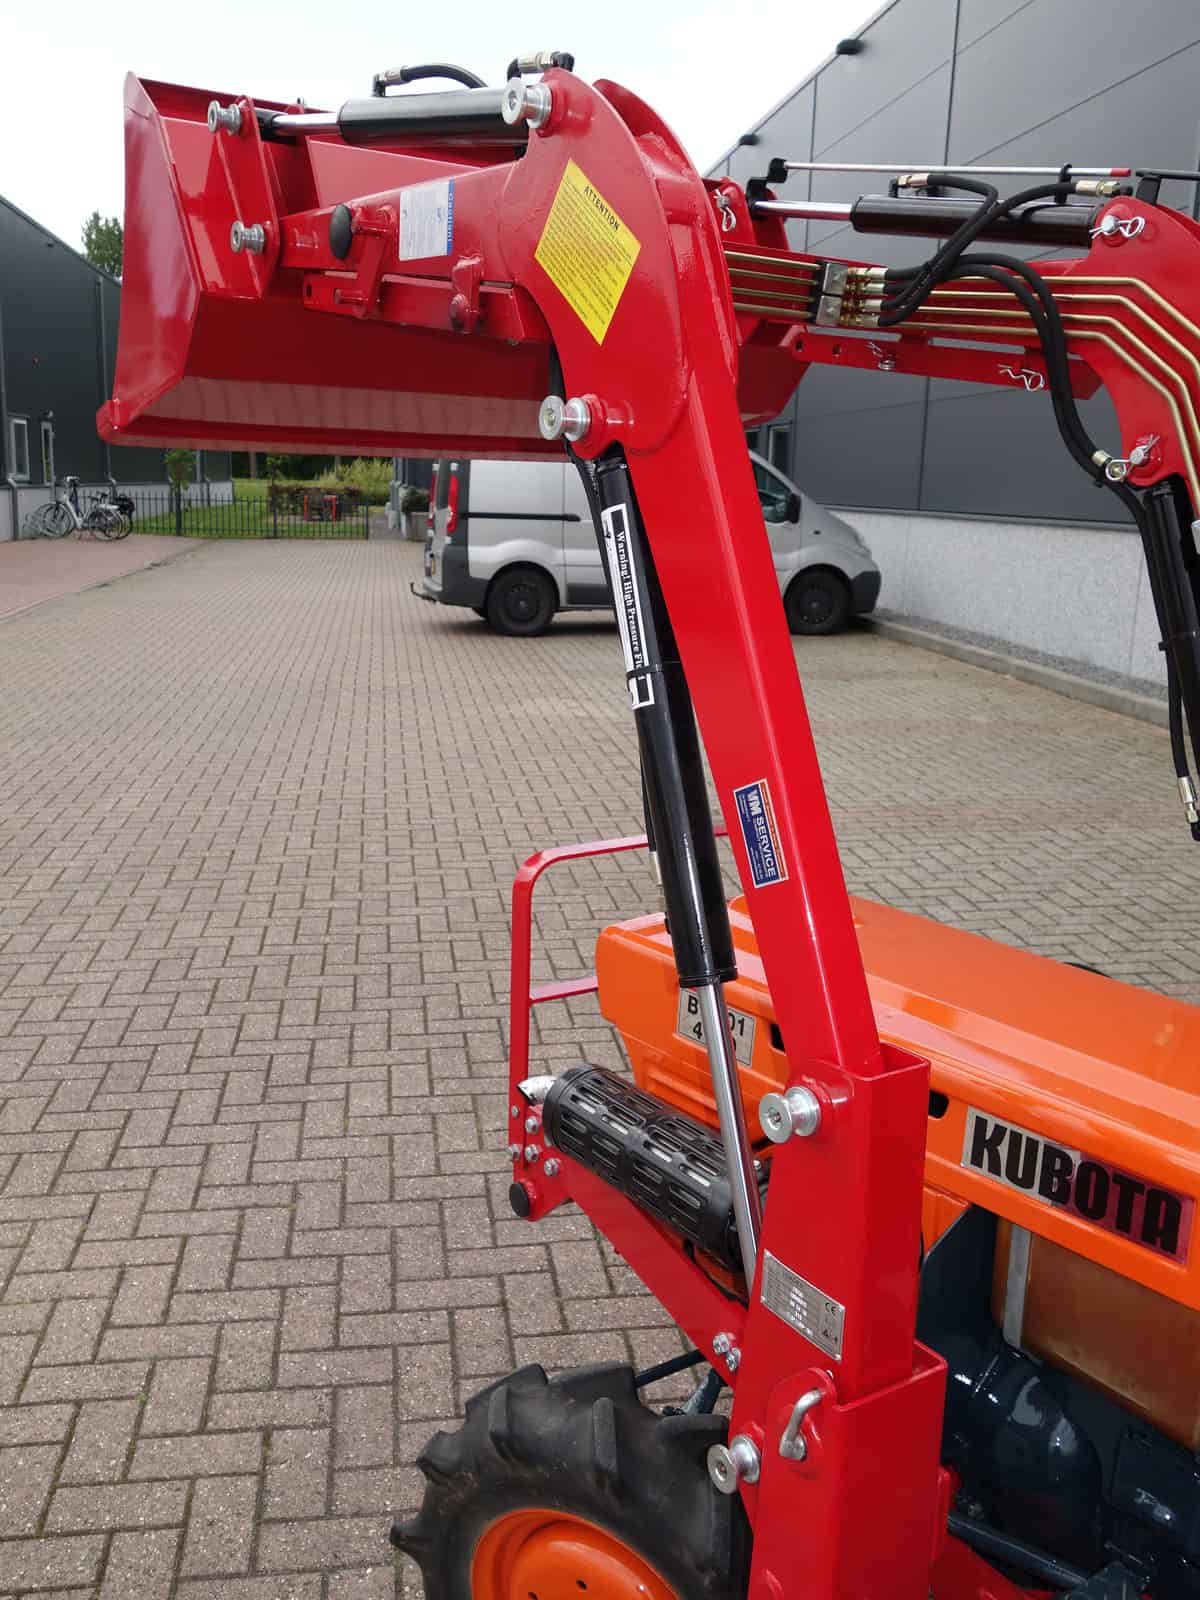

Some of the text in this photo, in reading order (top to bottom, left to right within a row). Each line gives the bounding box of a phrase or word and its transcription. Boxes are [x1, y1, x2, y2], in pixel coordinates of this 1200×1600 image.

[584, 186, 620, 231] ATTENTION
[616, 530, 630, 580] Warning!
[623, 582, 634, 607] High
[626, 608, 641, 653] Pressure
[747, 790, 762, 816] VM
[756, 816, 777, 878] SERVICE
[970, 1115, 1182, 1255] KUBOTA
